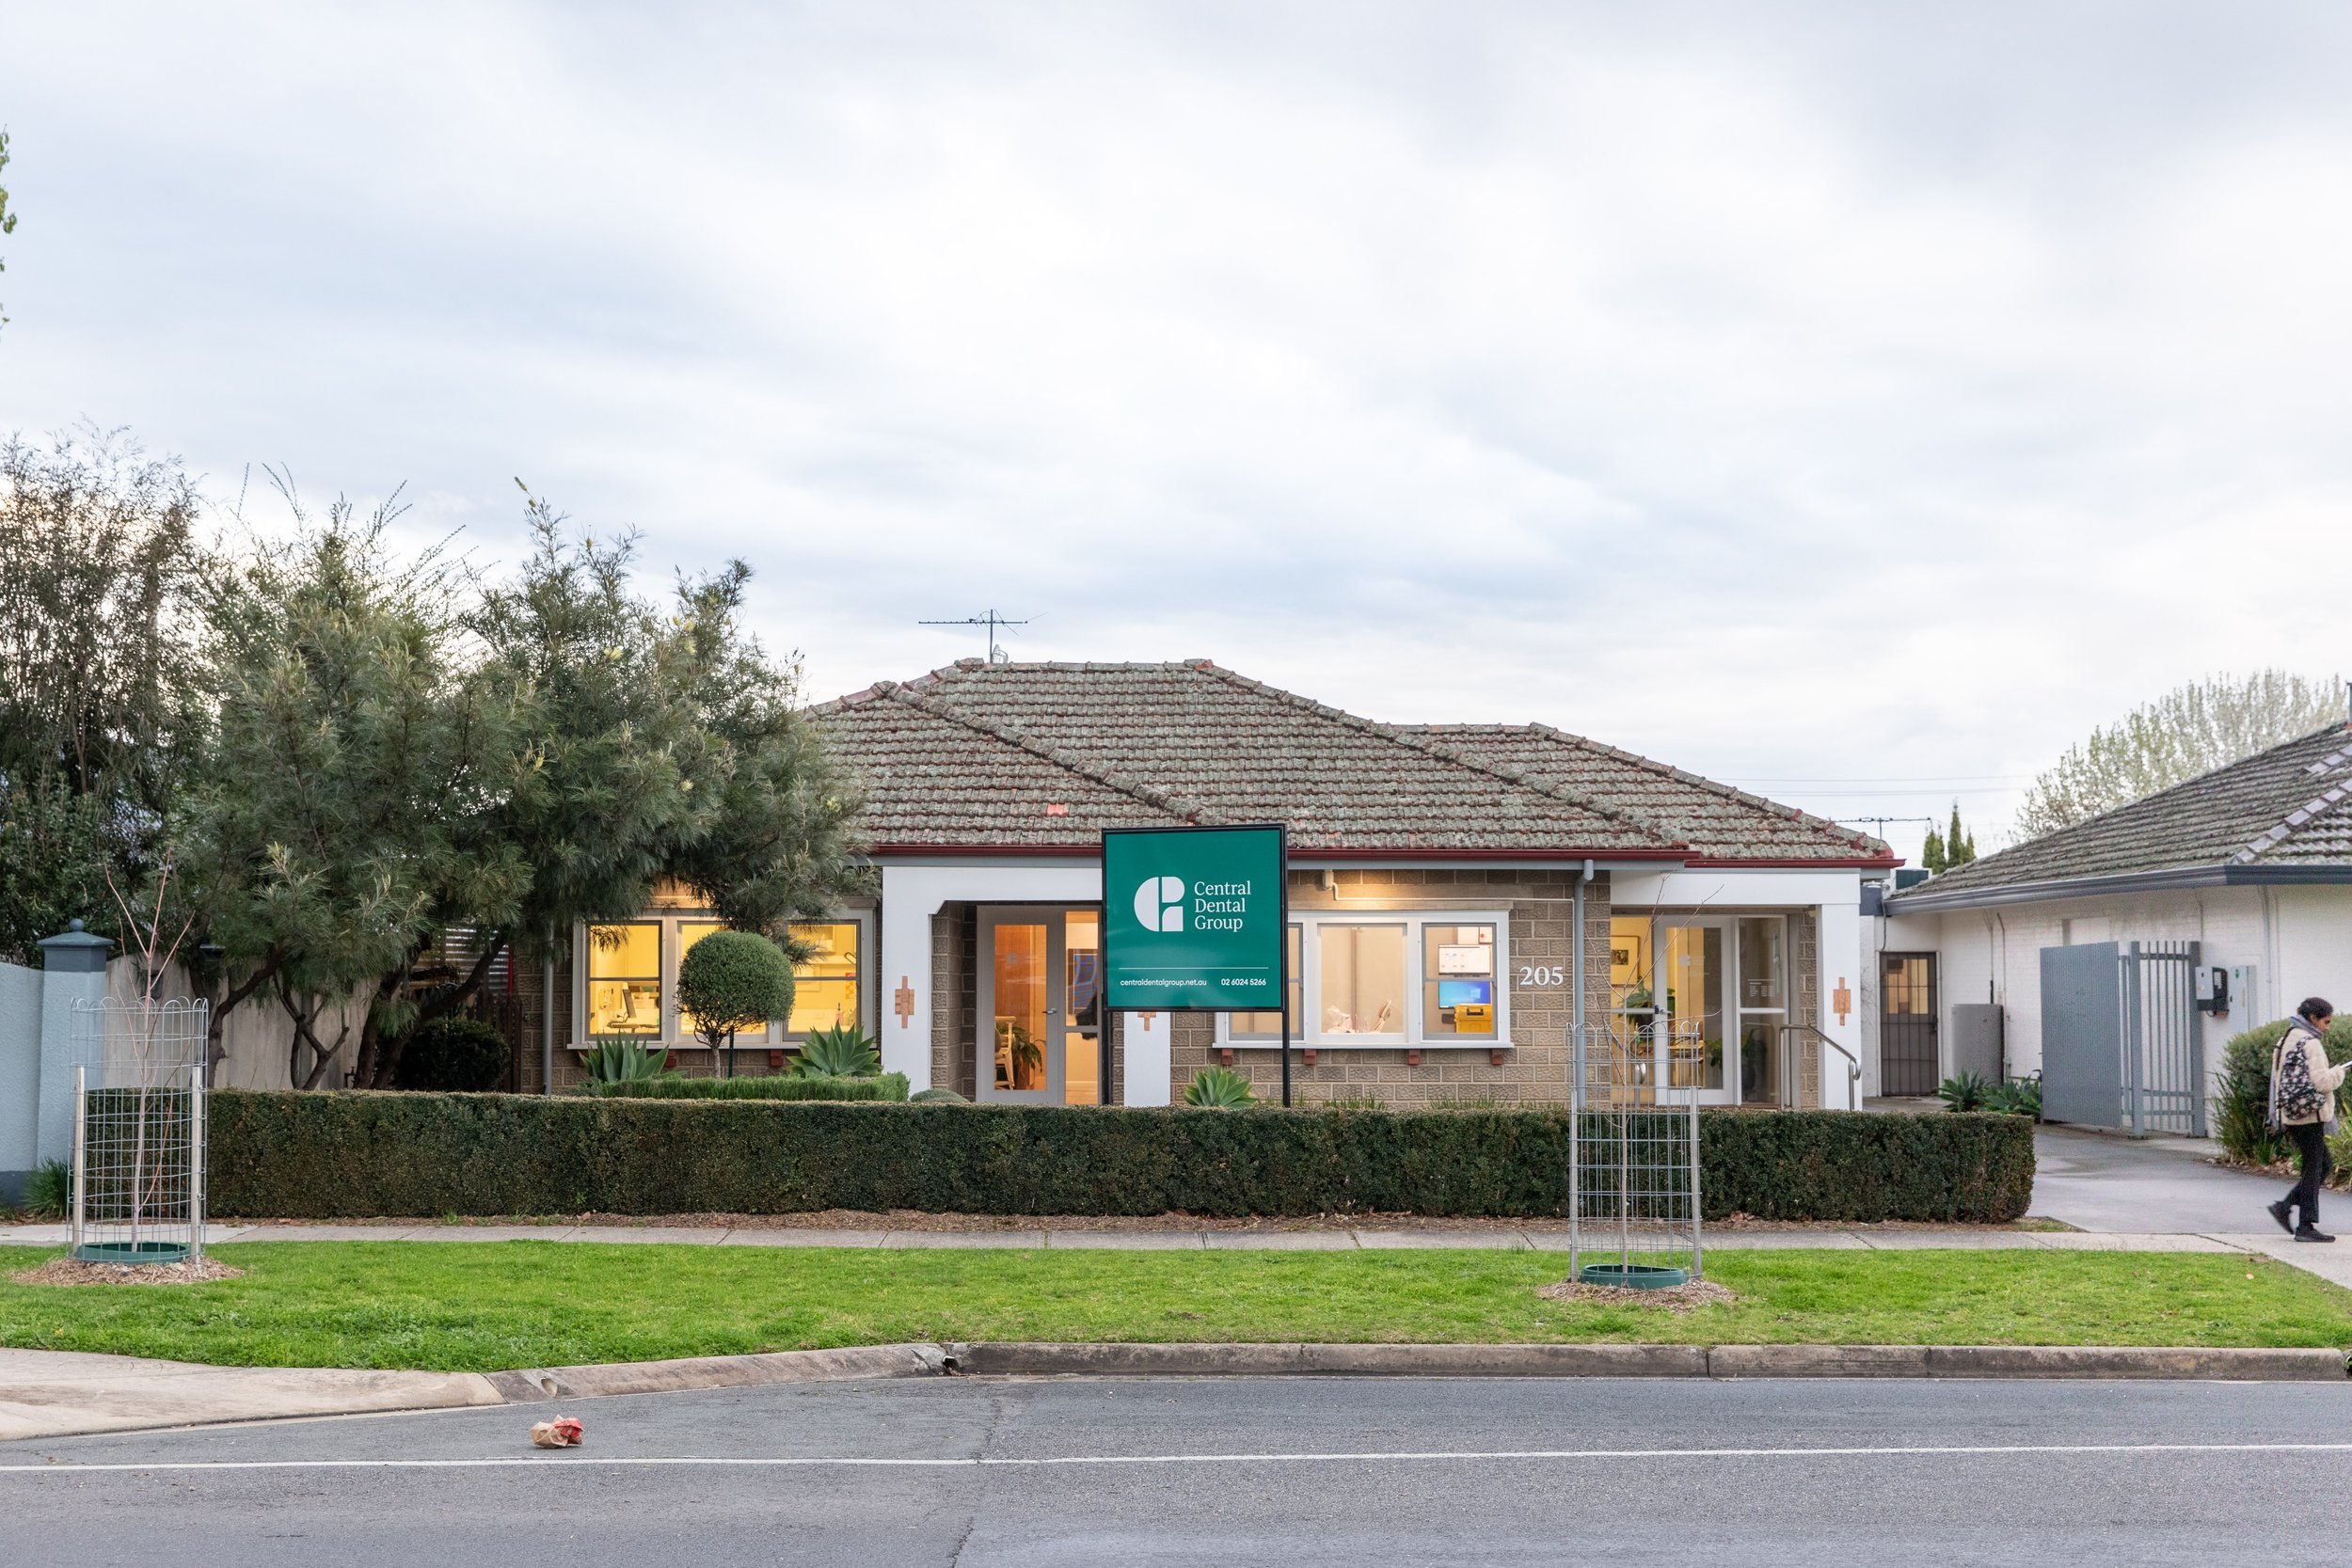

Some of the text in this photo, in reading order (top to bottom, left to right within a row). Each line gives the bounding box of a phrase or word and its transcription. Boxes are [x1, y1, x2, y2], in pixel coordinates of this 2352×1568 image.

[1194, 880, 1251, 895] Central
[1194, 897, 1246, 913] Dental
[1194, 915, 1244, 932] Group
[1120, 978, 1207, 988] centraldentalgroup.net.au
[1519, 966, 1564, 986] 205
